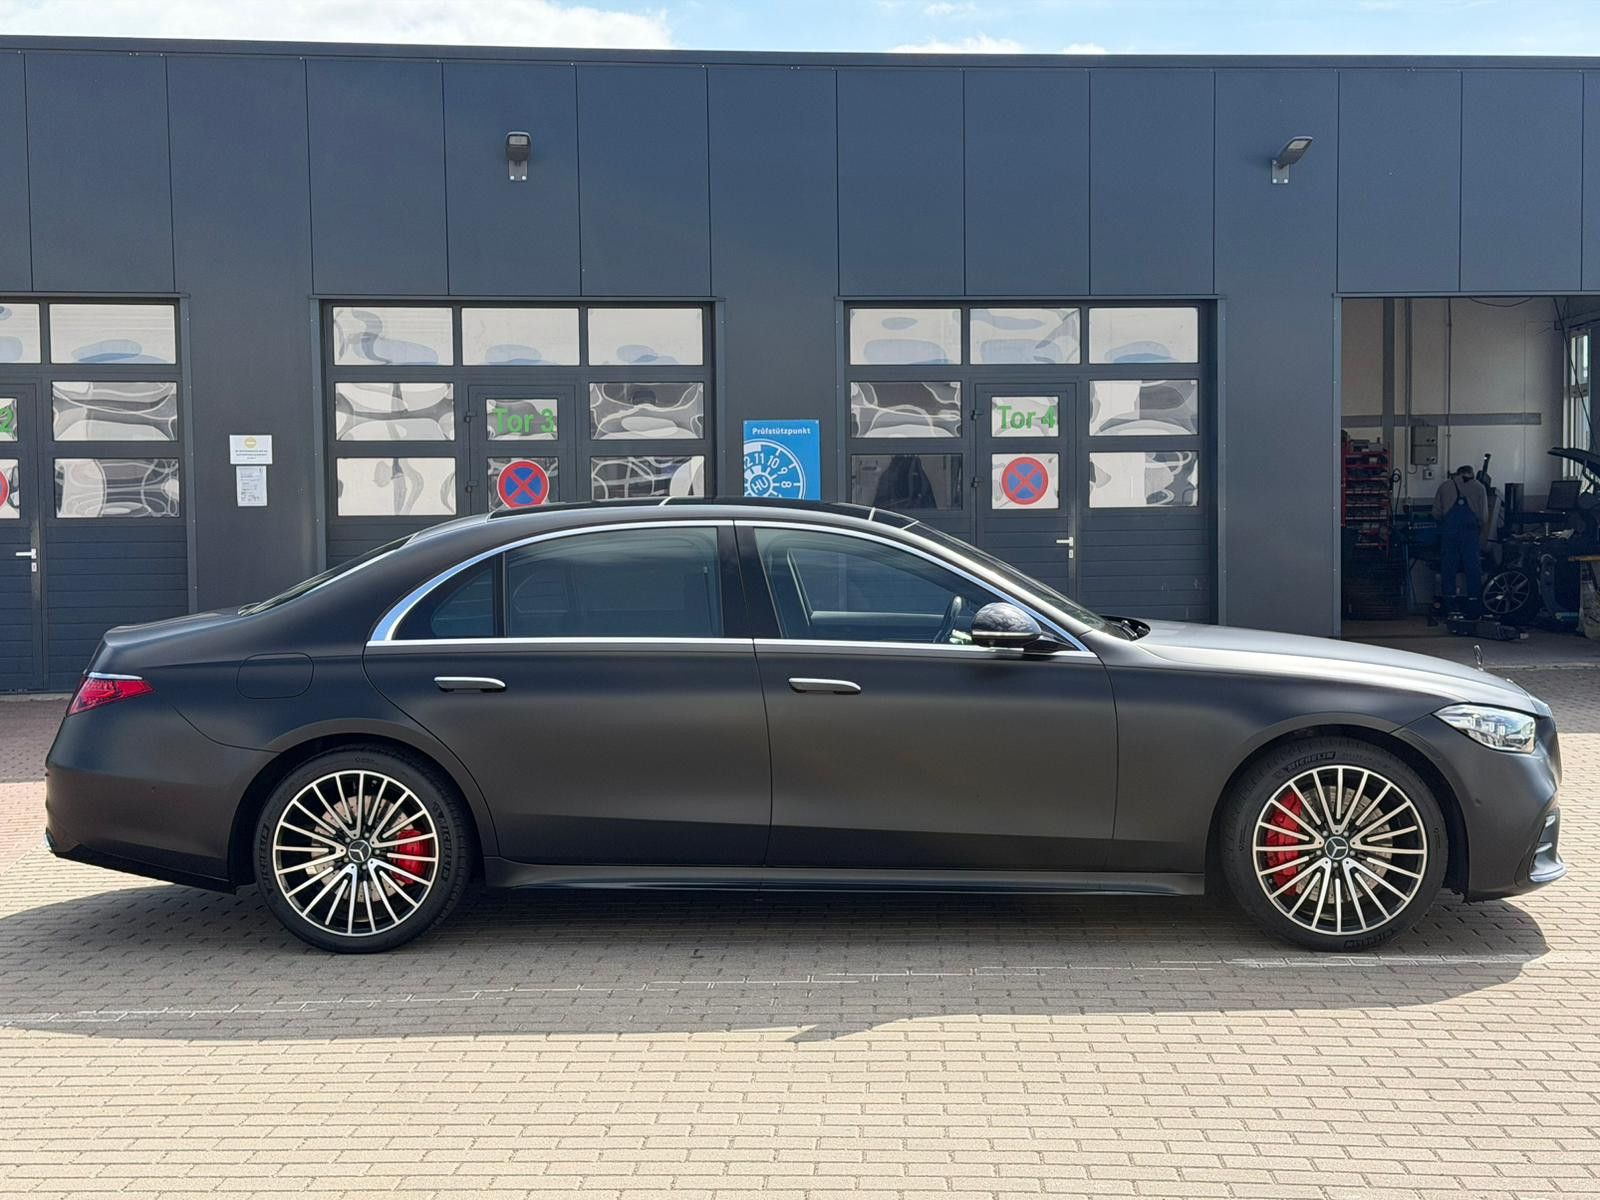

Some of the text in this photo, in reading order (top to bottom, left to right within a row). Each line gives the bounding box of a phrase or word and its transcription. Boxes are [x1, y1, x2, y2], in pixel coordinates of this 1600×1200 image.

[494, 407, 555, 433] Tor 3
[998, 405, 1056, 430] Tor 4
[752, 427, 811, 436] Prüfstützpunkt
[744, 456, 753, 469] 2
[754, 452, 764, 465] 11
[768, 454, 780, 468] 10
[751, 477, 769, 493] HU
